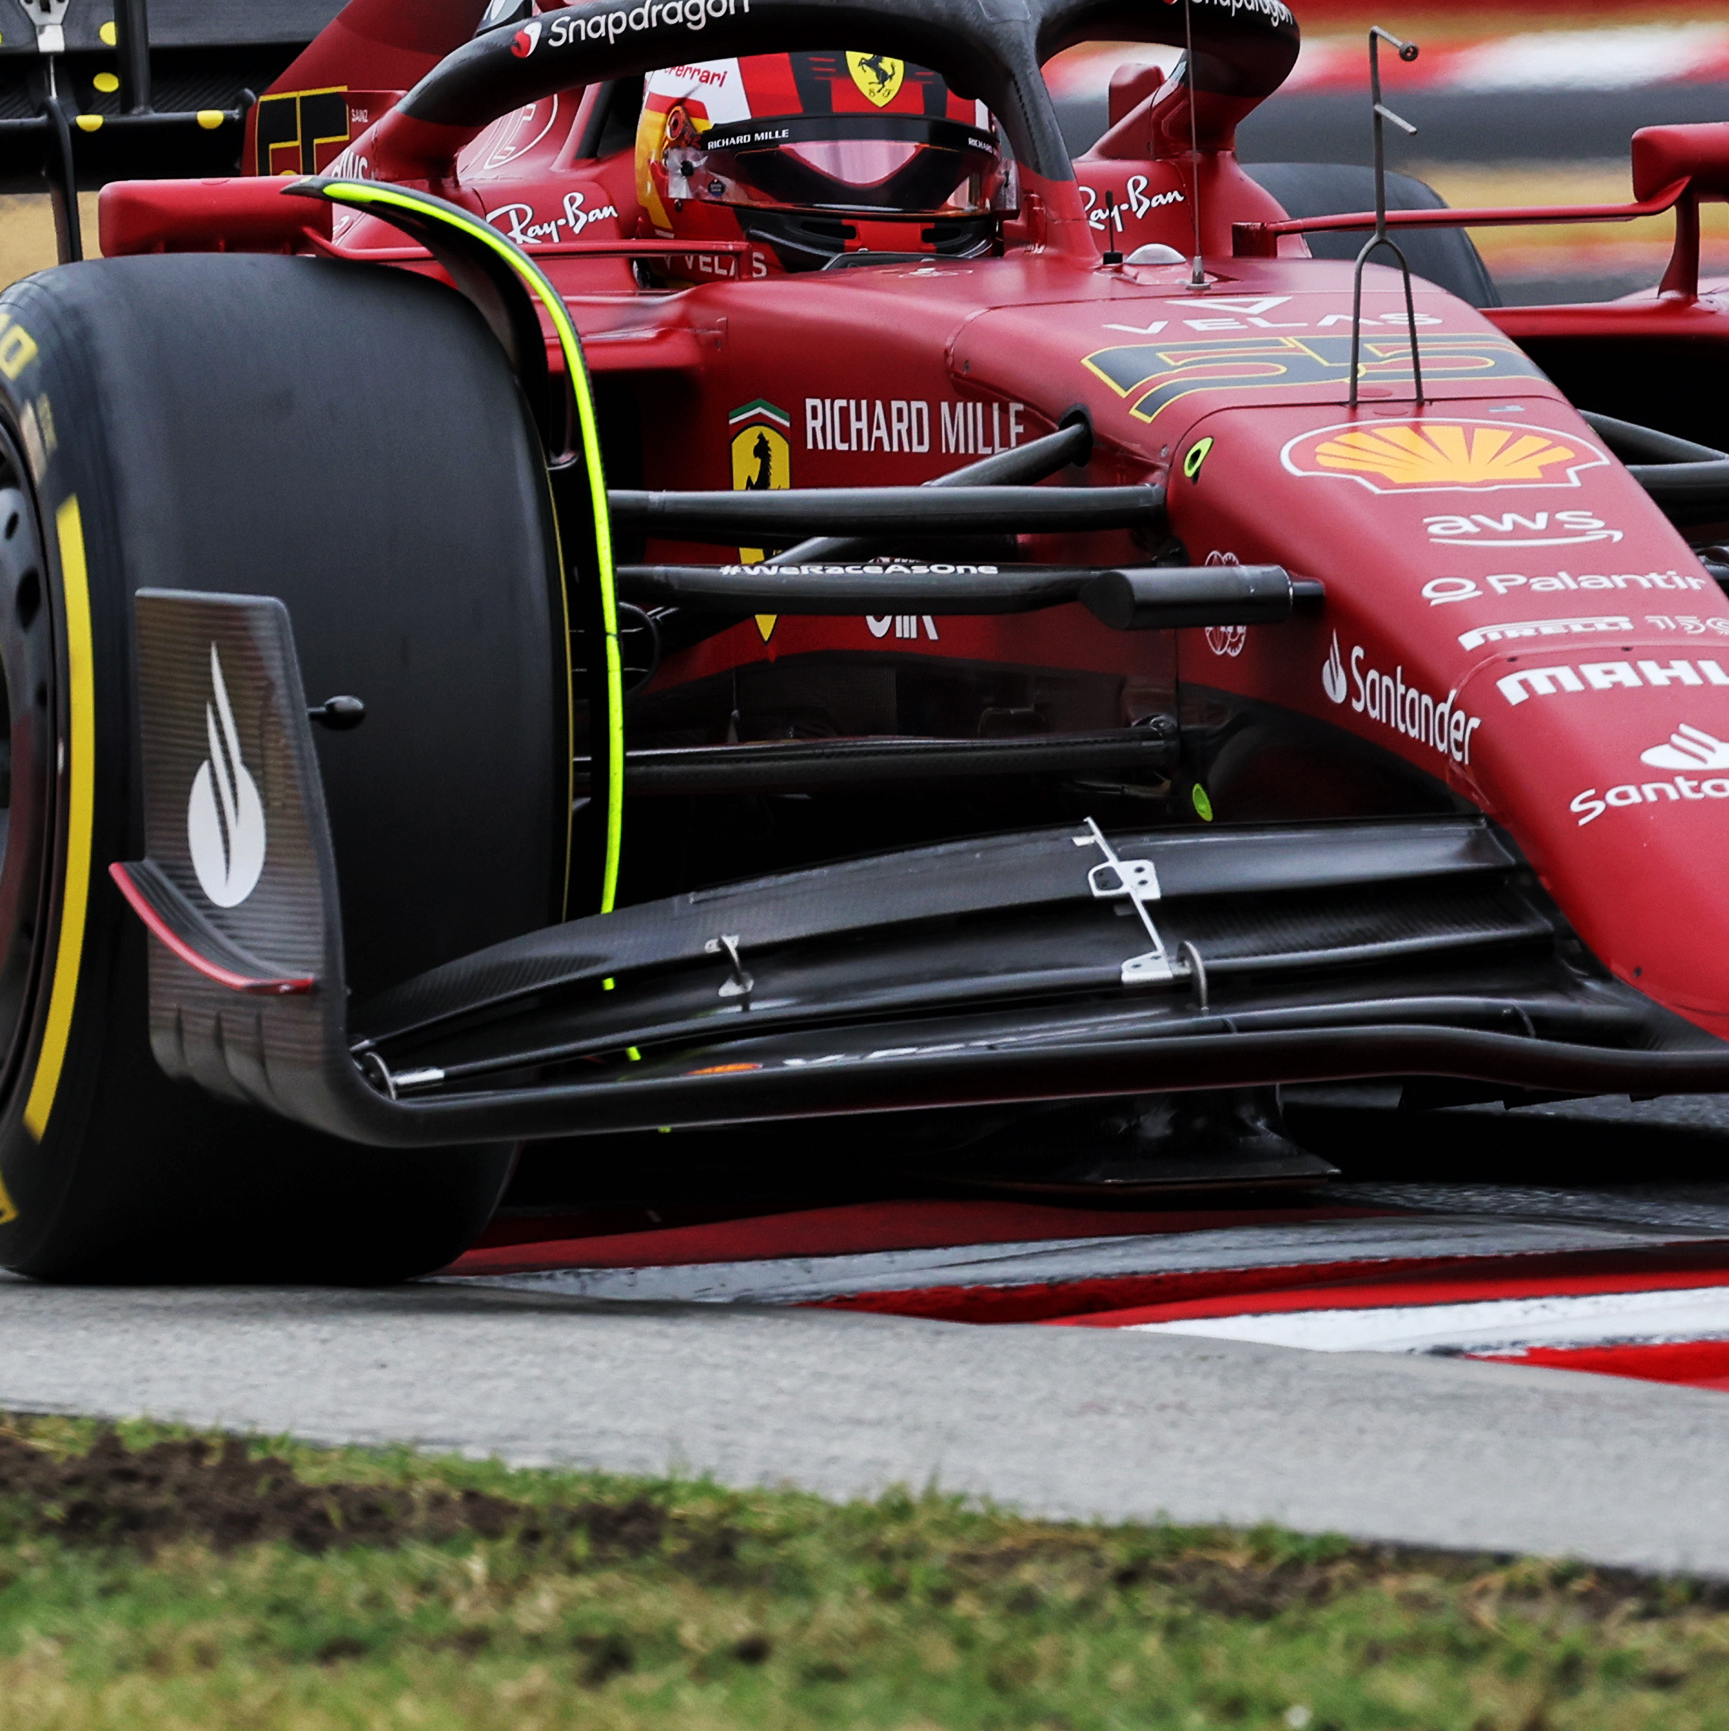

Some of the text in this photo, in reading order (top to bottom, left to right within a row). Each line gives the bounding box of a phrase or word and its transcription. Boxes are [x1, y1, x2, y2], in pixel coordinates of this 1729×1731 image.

[351, 109, 369, 123] SAINZ
[708, 128, 790, 150] RICHARD MILLE
[1102, 311, 1443, 334] VELAS
[805, 397, 930, 454] RICHARD
[1423, 510, 1606, 536] aws
[720, 564, 999, 576] #WeRaceAsOne
[1486, 571, 1706, 595] Palantir
[1457, 615, 1635, 651] PIRELLI
[1351, 645, 1482, 765] Santander
